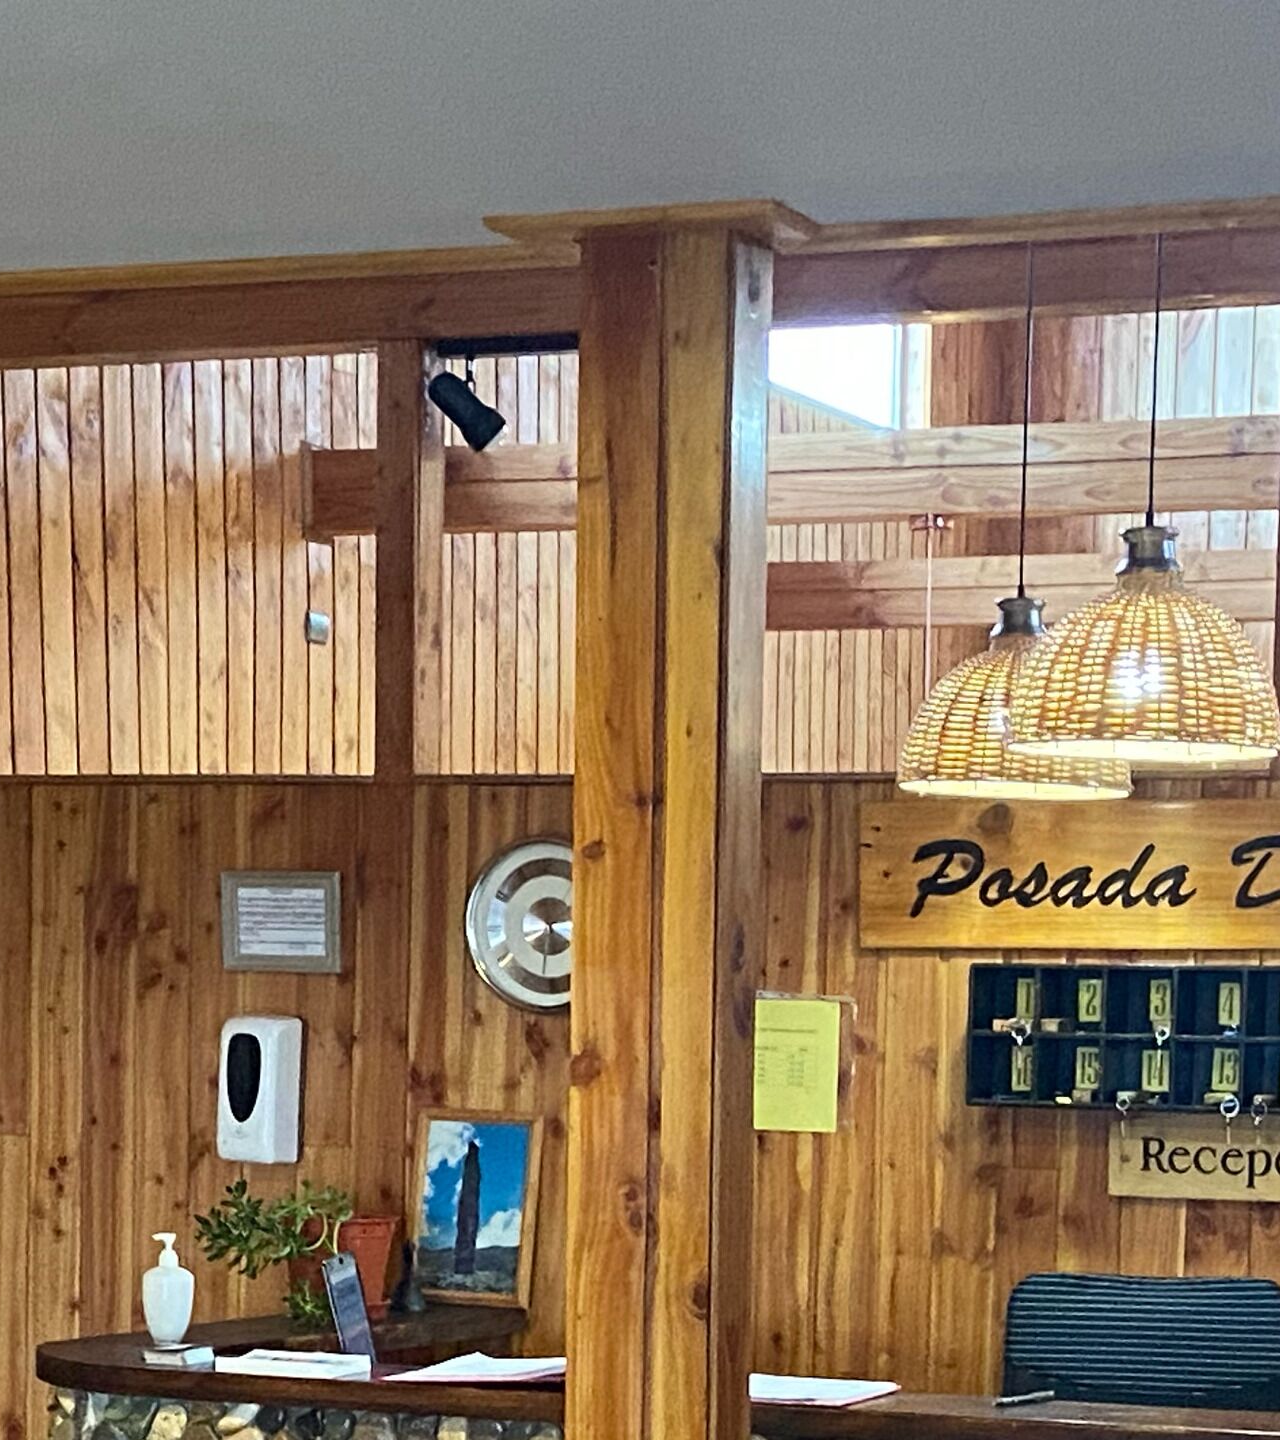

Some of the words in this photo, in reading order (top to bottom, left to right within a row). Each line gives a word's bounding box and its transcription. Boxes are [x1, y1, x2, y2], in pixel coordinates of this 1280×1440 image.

[910, 839, 1197, 918] Posada
[1024, 981, 1032, 1019] 1
[1085, 984, 1098, 1016] 2
[1154, 983, 1167, 1017] 3
[1222, 986, 1235, 1020] 4
[1017, 1053, 1032, 1088] 16
[1080, 1051, 1098, 1084] 15
[1147, 1053, 1164, 1087] 14
[1217, 1051, 1237, 1085] 13
